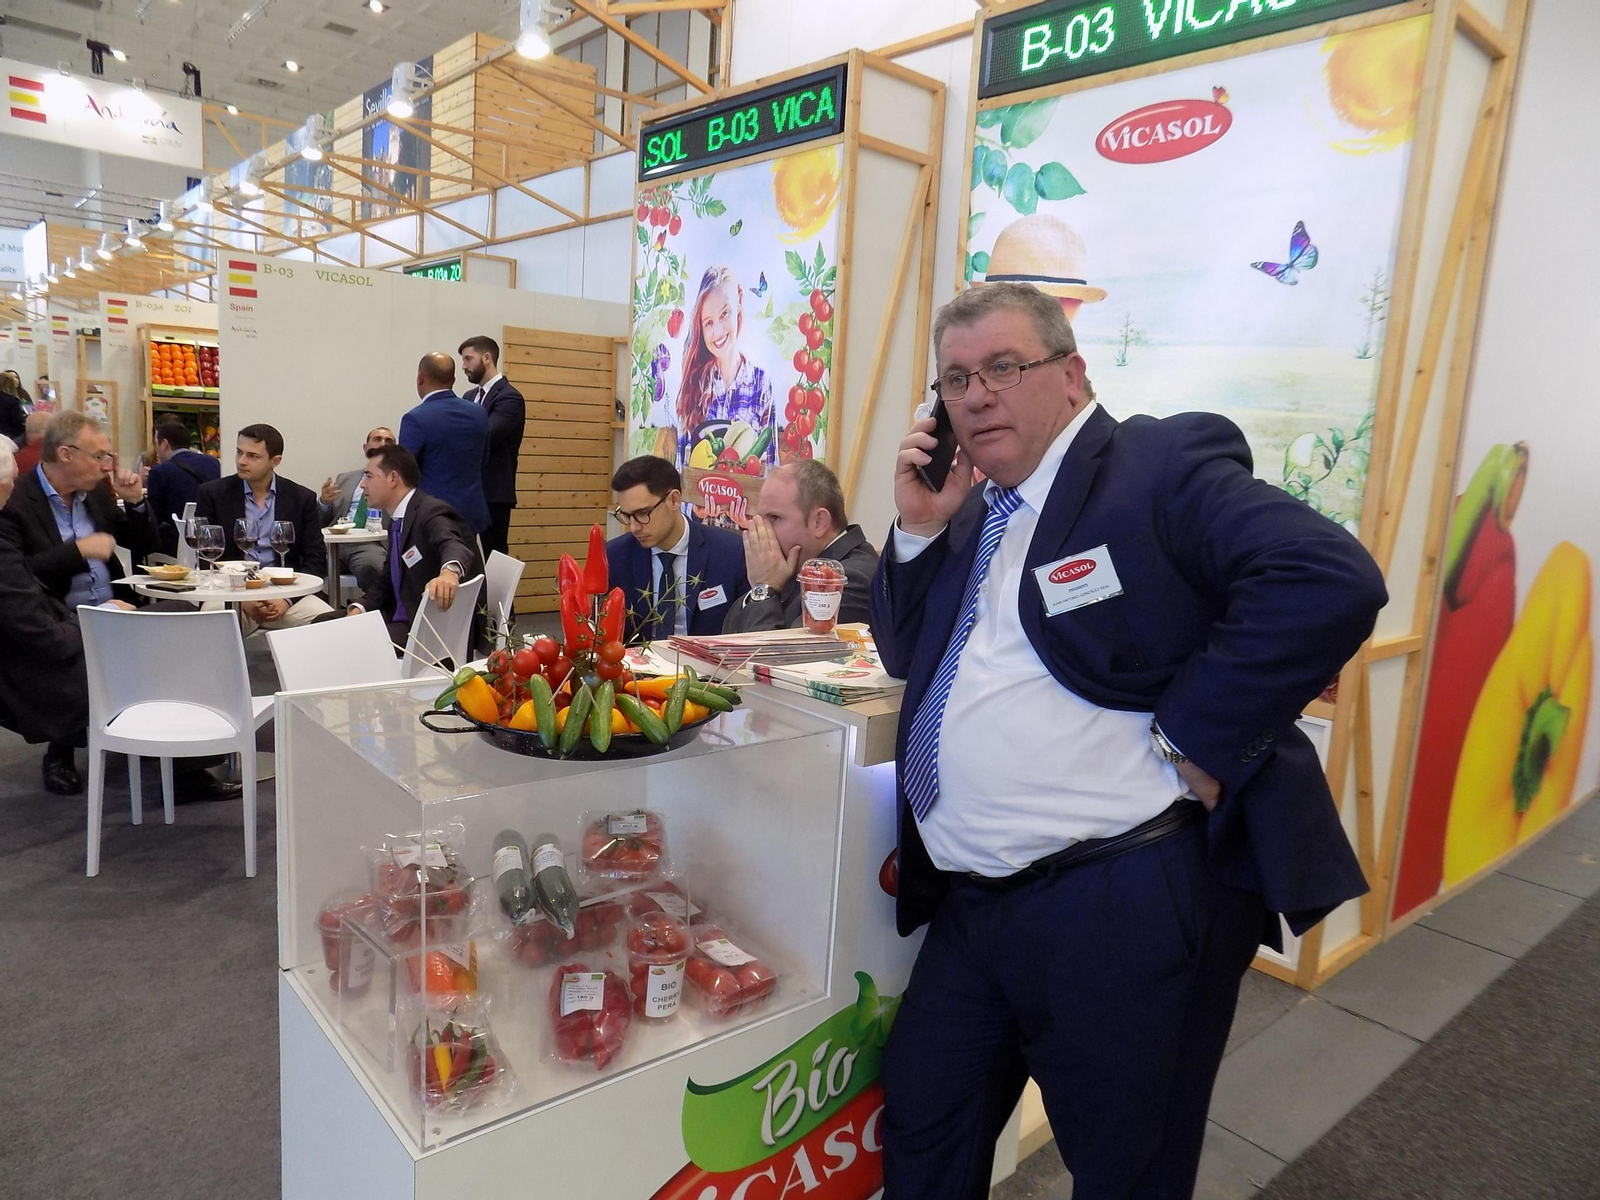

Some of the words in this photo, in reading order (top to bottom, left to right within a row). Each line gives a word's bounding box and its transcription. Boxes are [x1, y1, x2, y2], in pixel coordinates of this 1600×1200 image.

[1020, 6, 1116, 72] B-03
[1142, 0, 1298, 40] VIC
[643, 129, 689, 169] SOL
[706, 106, 760, 152] B-03
[771, 85, 836, 134] VICA
[263, 263, 294, 279] B-03
[315, 269, 374, 287] VICASOL
[229, 302, 254, 312] Spain
[661, 981, 677, 991] BIO
[652, 991, 680, 1003] CHERRY
[657, 1001, 676, 1011] PERA
[752, 1038, 860, 1146] Bio
